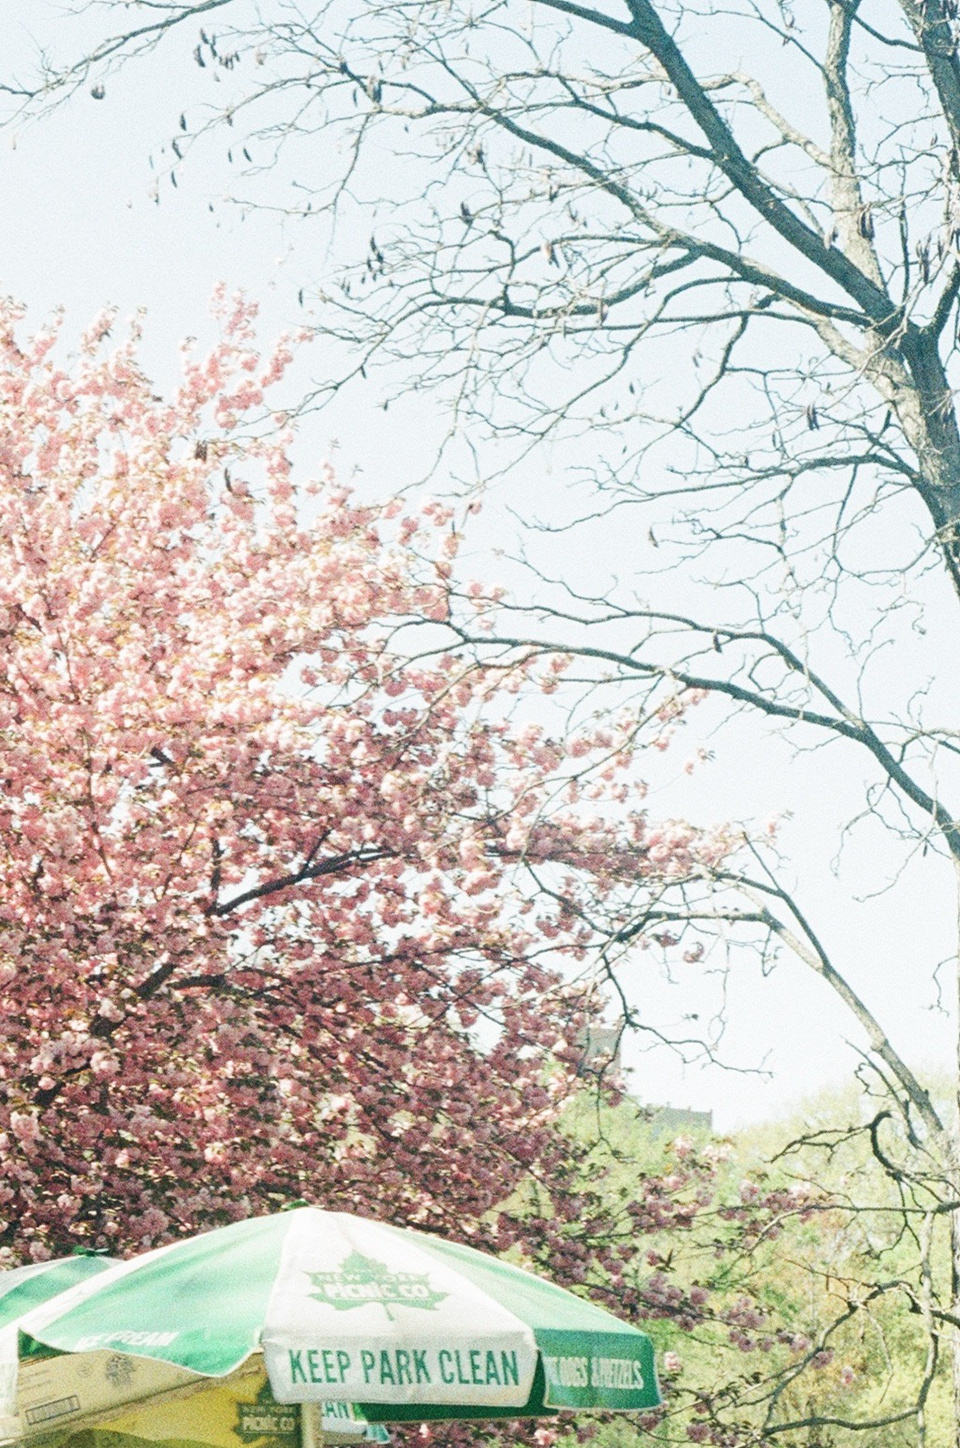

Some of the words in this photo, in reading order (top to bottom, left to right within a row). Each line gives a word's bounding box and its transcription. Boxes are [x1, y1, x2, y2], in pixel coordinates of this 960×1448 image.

[324, 1281, 397, 1298] PICNIC
[398, 1284, 430, 1298] CO
[289, 1349, 351, 1385] KEEP
[361, 1349, 431, 1386] PARK
[439, 1349, 520, 1387] CLEAN
[242, 1414, 279, 1431] PICNIC
[279, 1416, 295, 1431] CO
